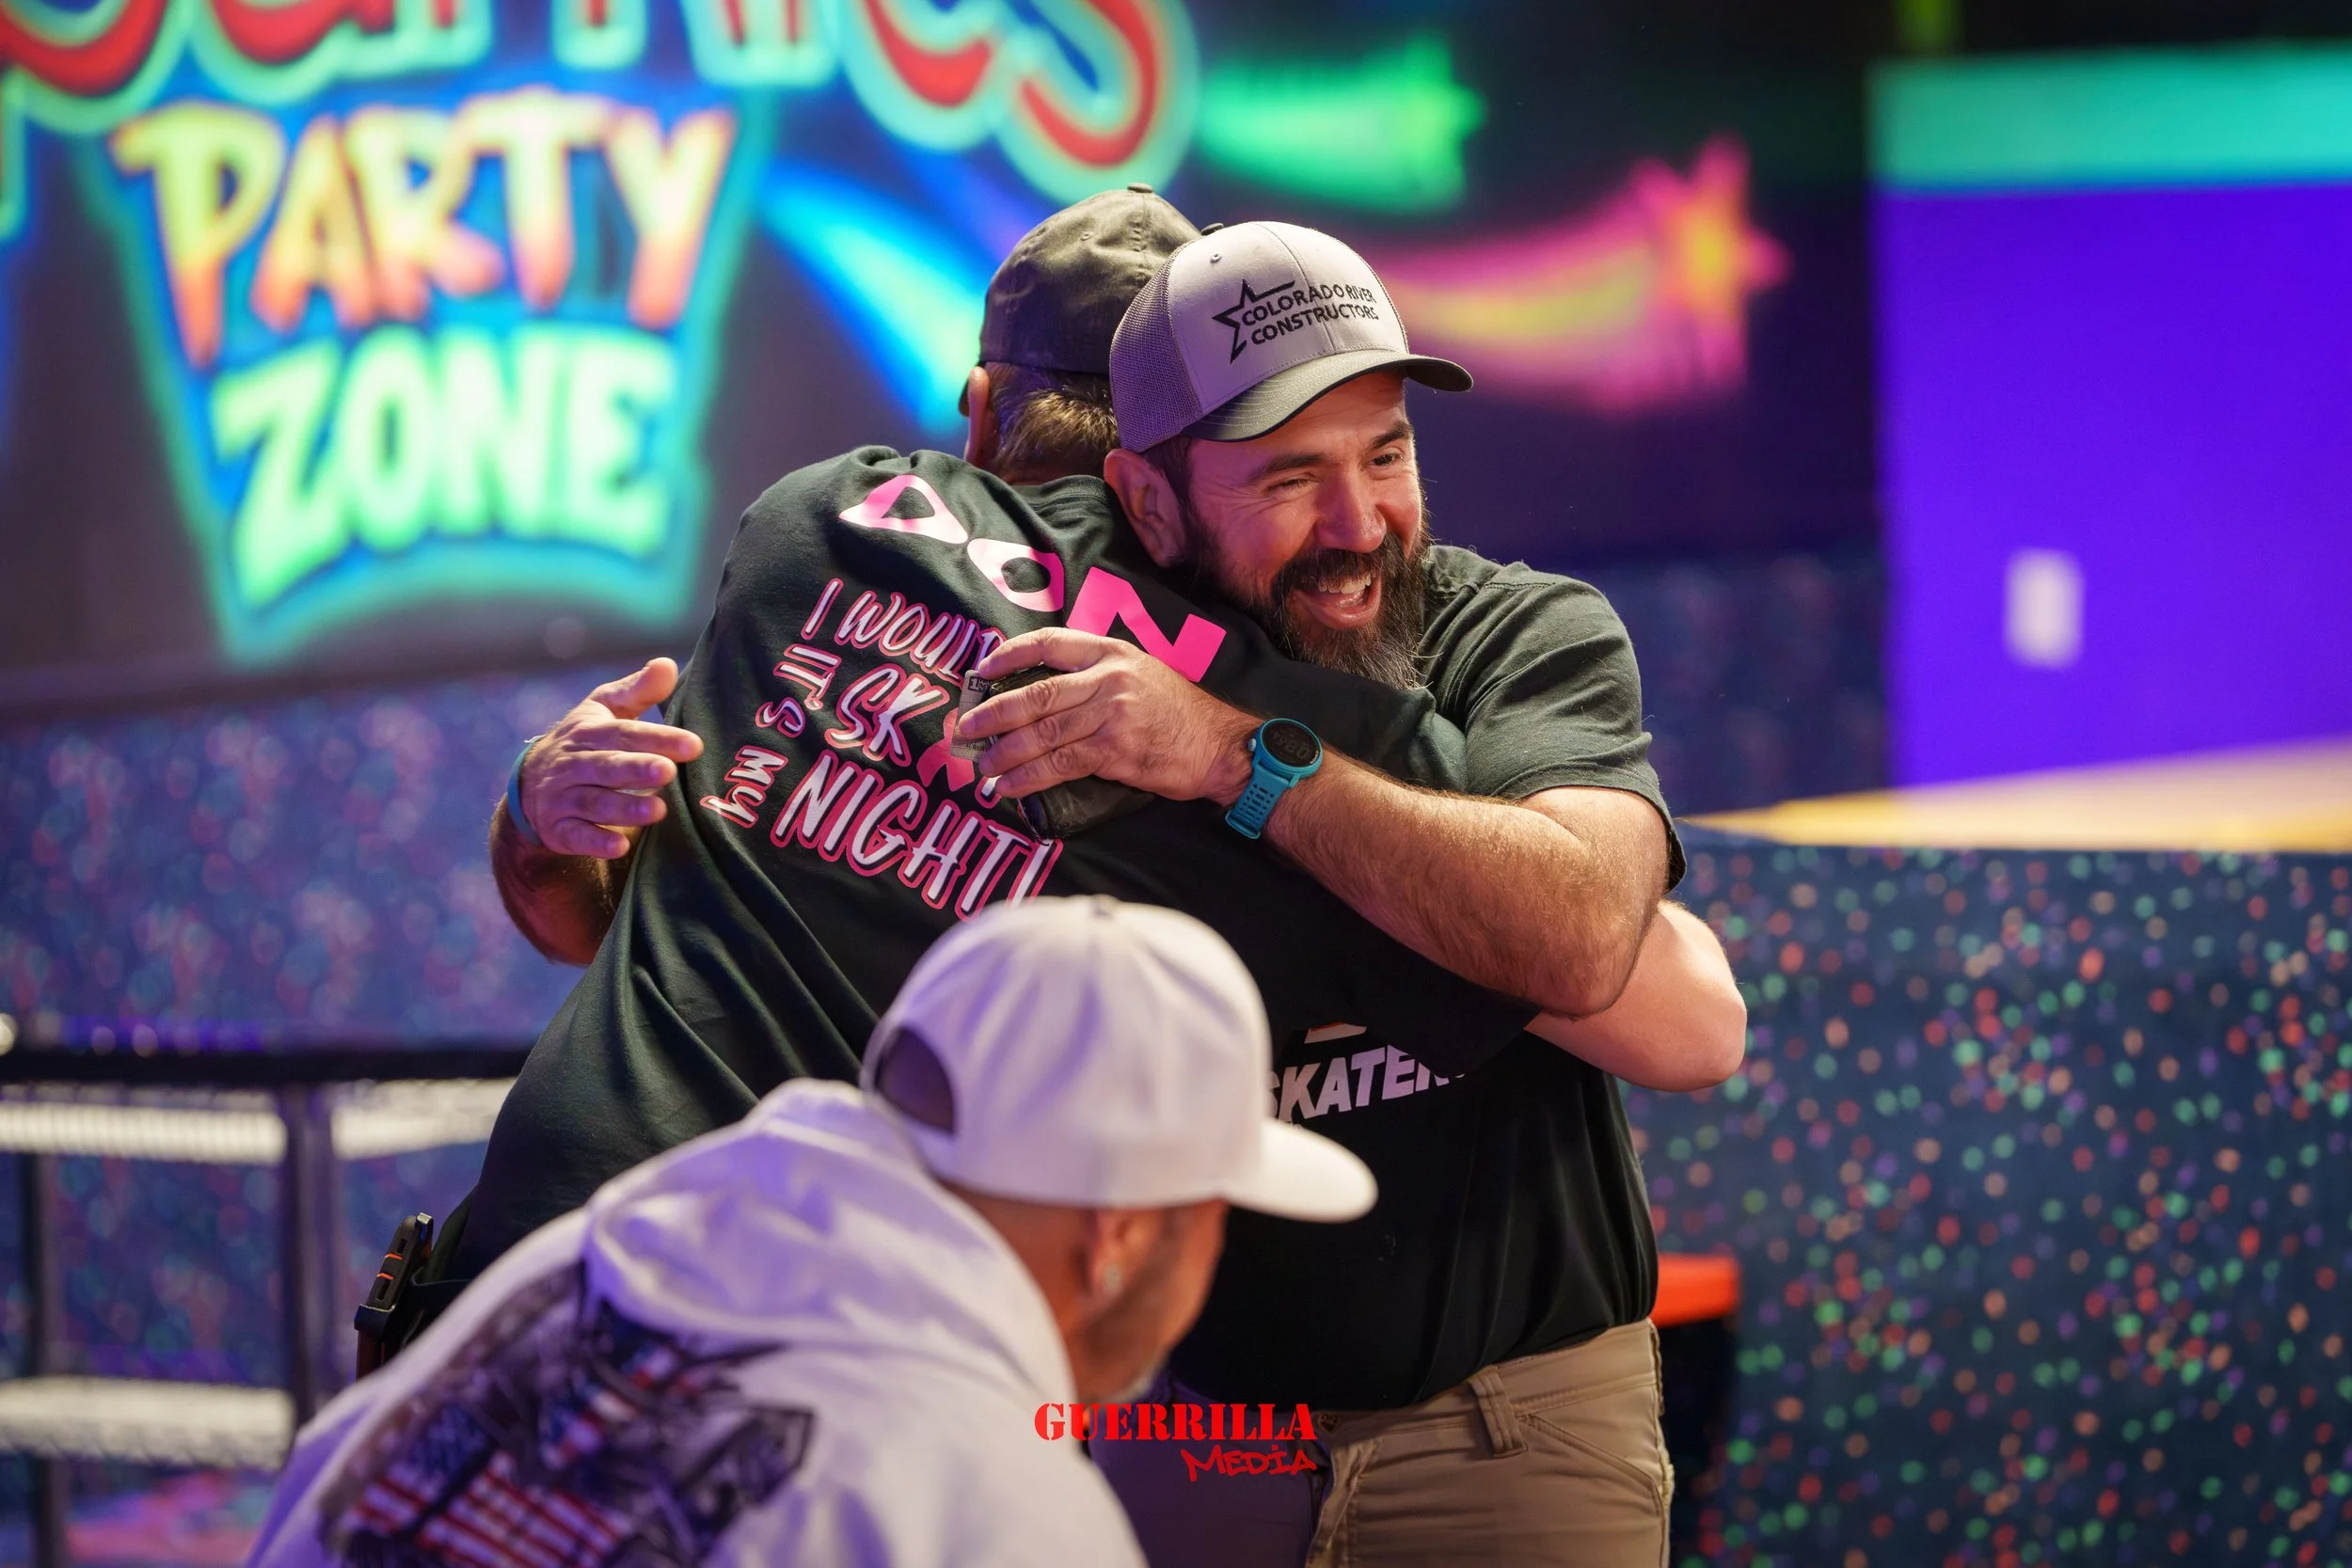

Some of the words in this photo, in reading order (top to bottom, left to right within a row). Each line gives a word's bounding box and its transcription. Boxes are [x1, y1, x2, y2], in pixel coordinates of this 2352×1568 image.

[110, 87, 737, 365] PARTY
[1242, 284, 1344, 326] COLORADO
[1345, 284, 1376, 304] RIVER
[1251, 302, 1379, 345] CONSTRUCTORS
[213, 325, 679, 605] ZONE
[801, 578, 843, 640] I
[839, 474, 1227, 683] DON
